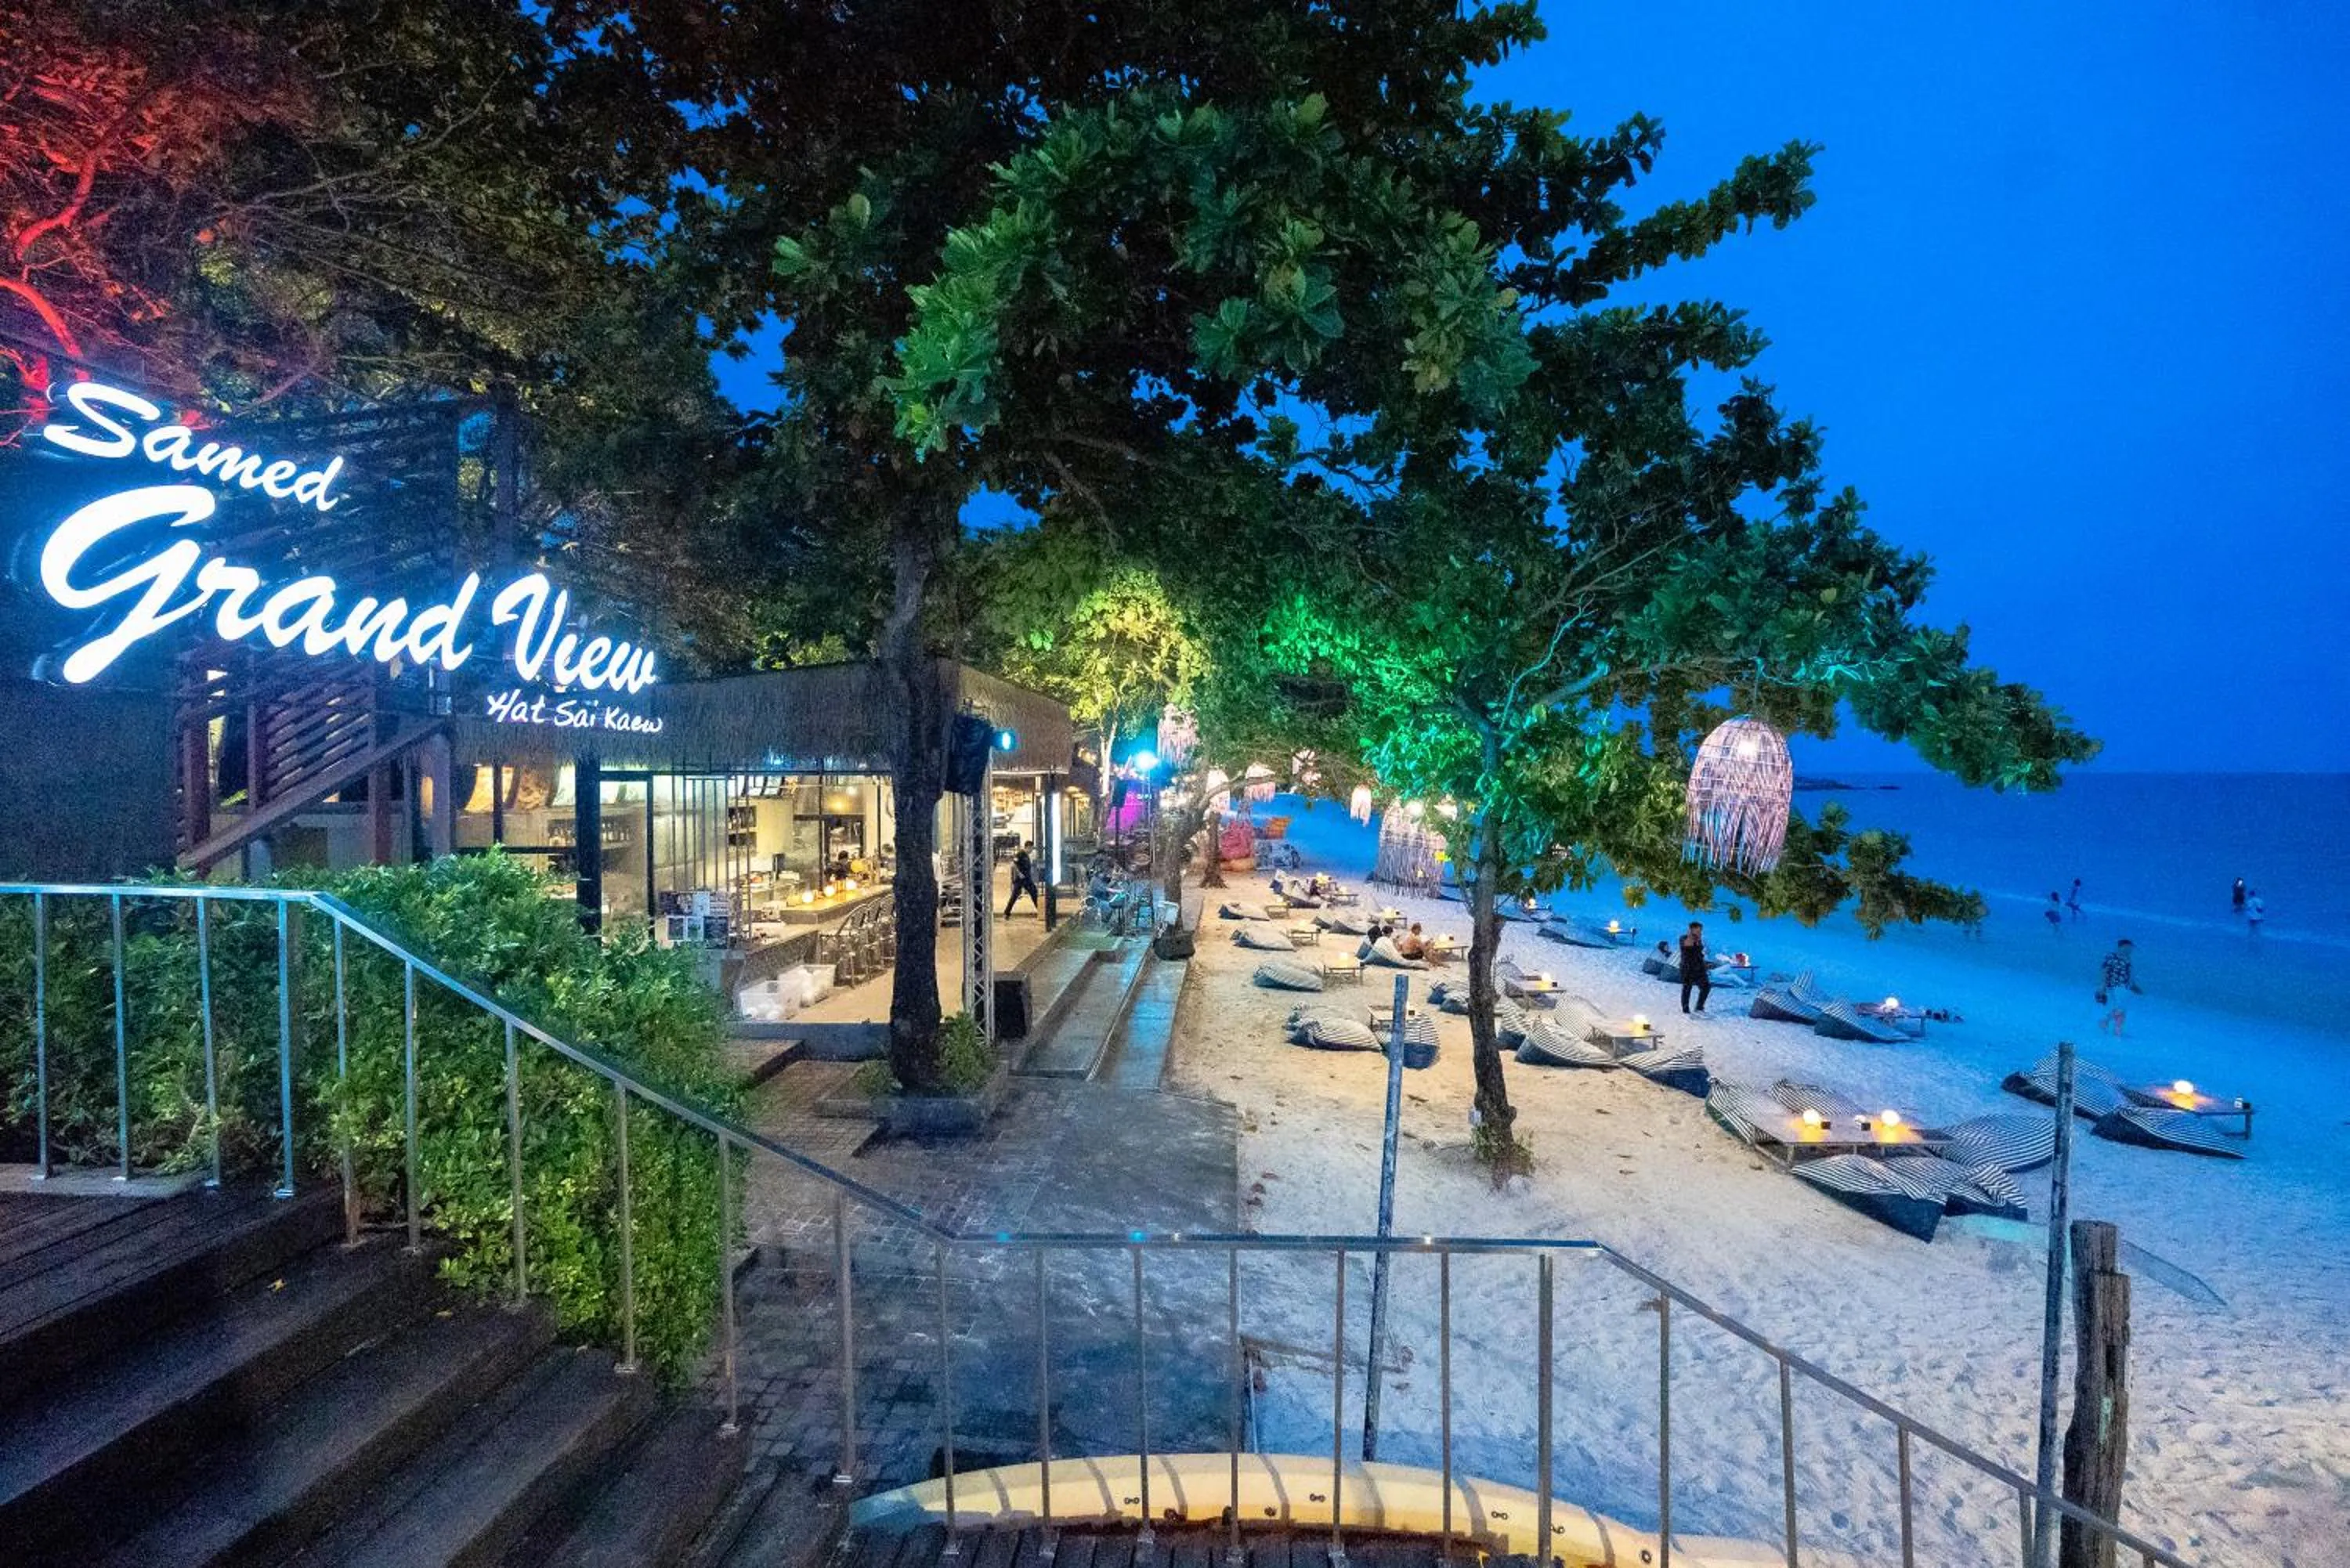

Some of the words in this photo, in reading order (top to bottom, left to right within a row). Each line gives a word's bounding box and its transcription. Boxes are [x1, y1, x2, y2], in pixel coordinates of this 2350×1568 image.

[43, 381, 344, 511] Samed
[40, 485, 480, 684] Grand
[491, 573, 656, 694] View
[486, 688, 546, 724] Hat
[553, 699, 599, 728] Sai
[604, 706, 663, 733] Kaew
